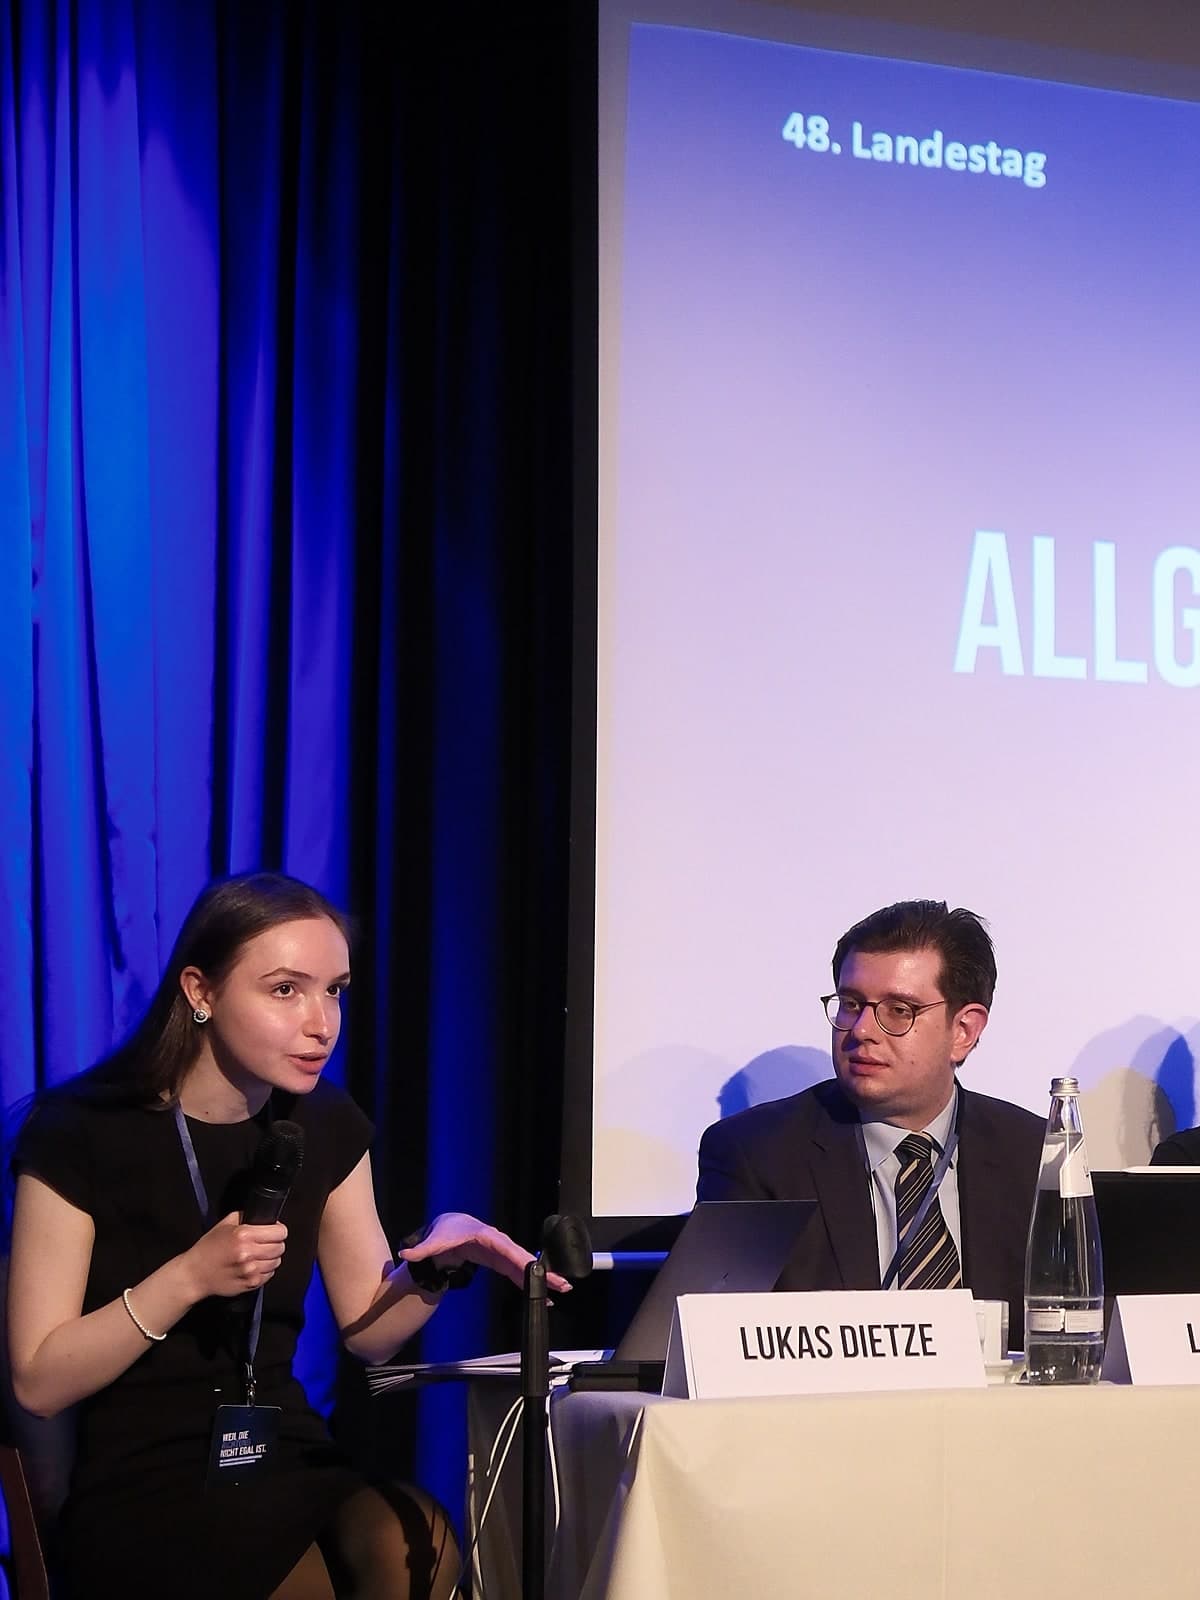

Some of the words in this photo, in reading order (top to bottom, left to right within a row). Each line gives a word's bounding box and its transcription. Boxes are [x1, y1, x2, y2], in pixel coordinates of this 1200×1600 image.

[782, 112, 842, 154] 48.
[853, 121, 1047, 188] Landestag
[740, 1325, 832, 1360] LUKAS
[840, 1323, 936, 1359] DIETZE
[238, 1430, 249, 1440] DIE
[220, 1447, 238, 1458] NICHT
[239, 1445, 254, 1456] EGAL
